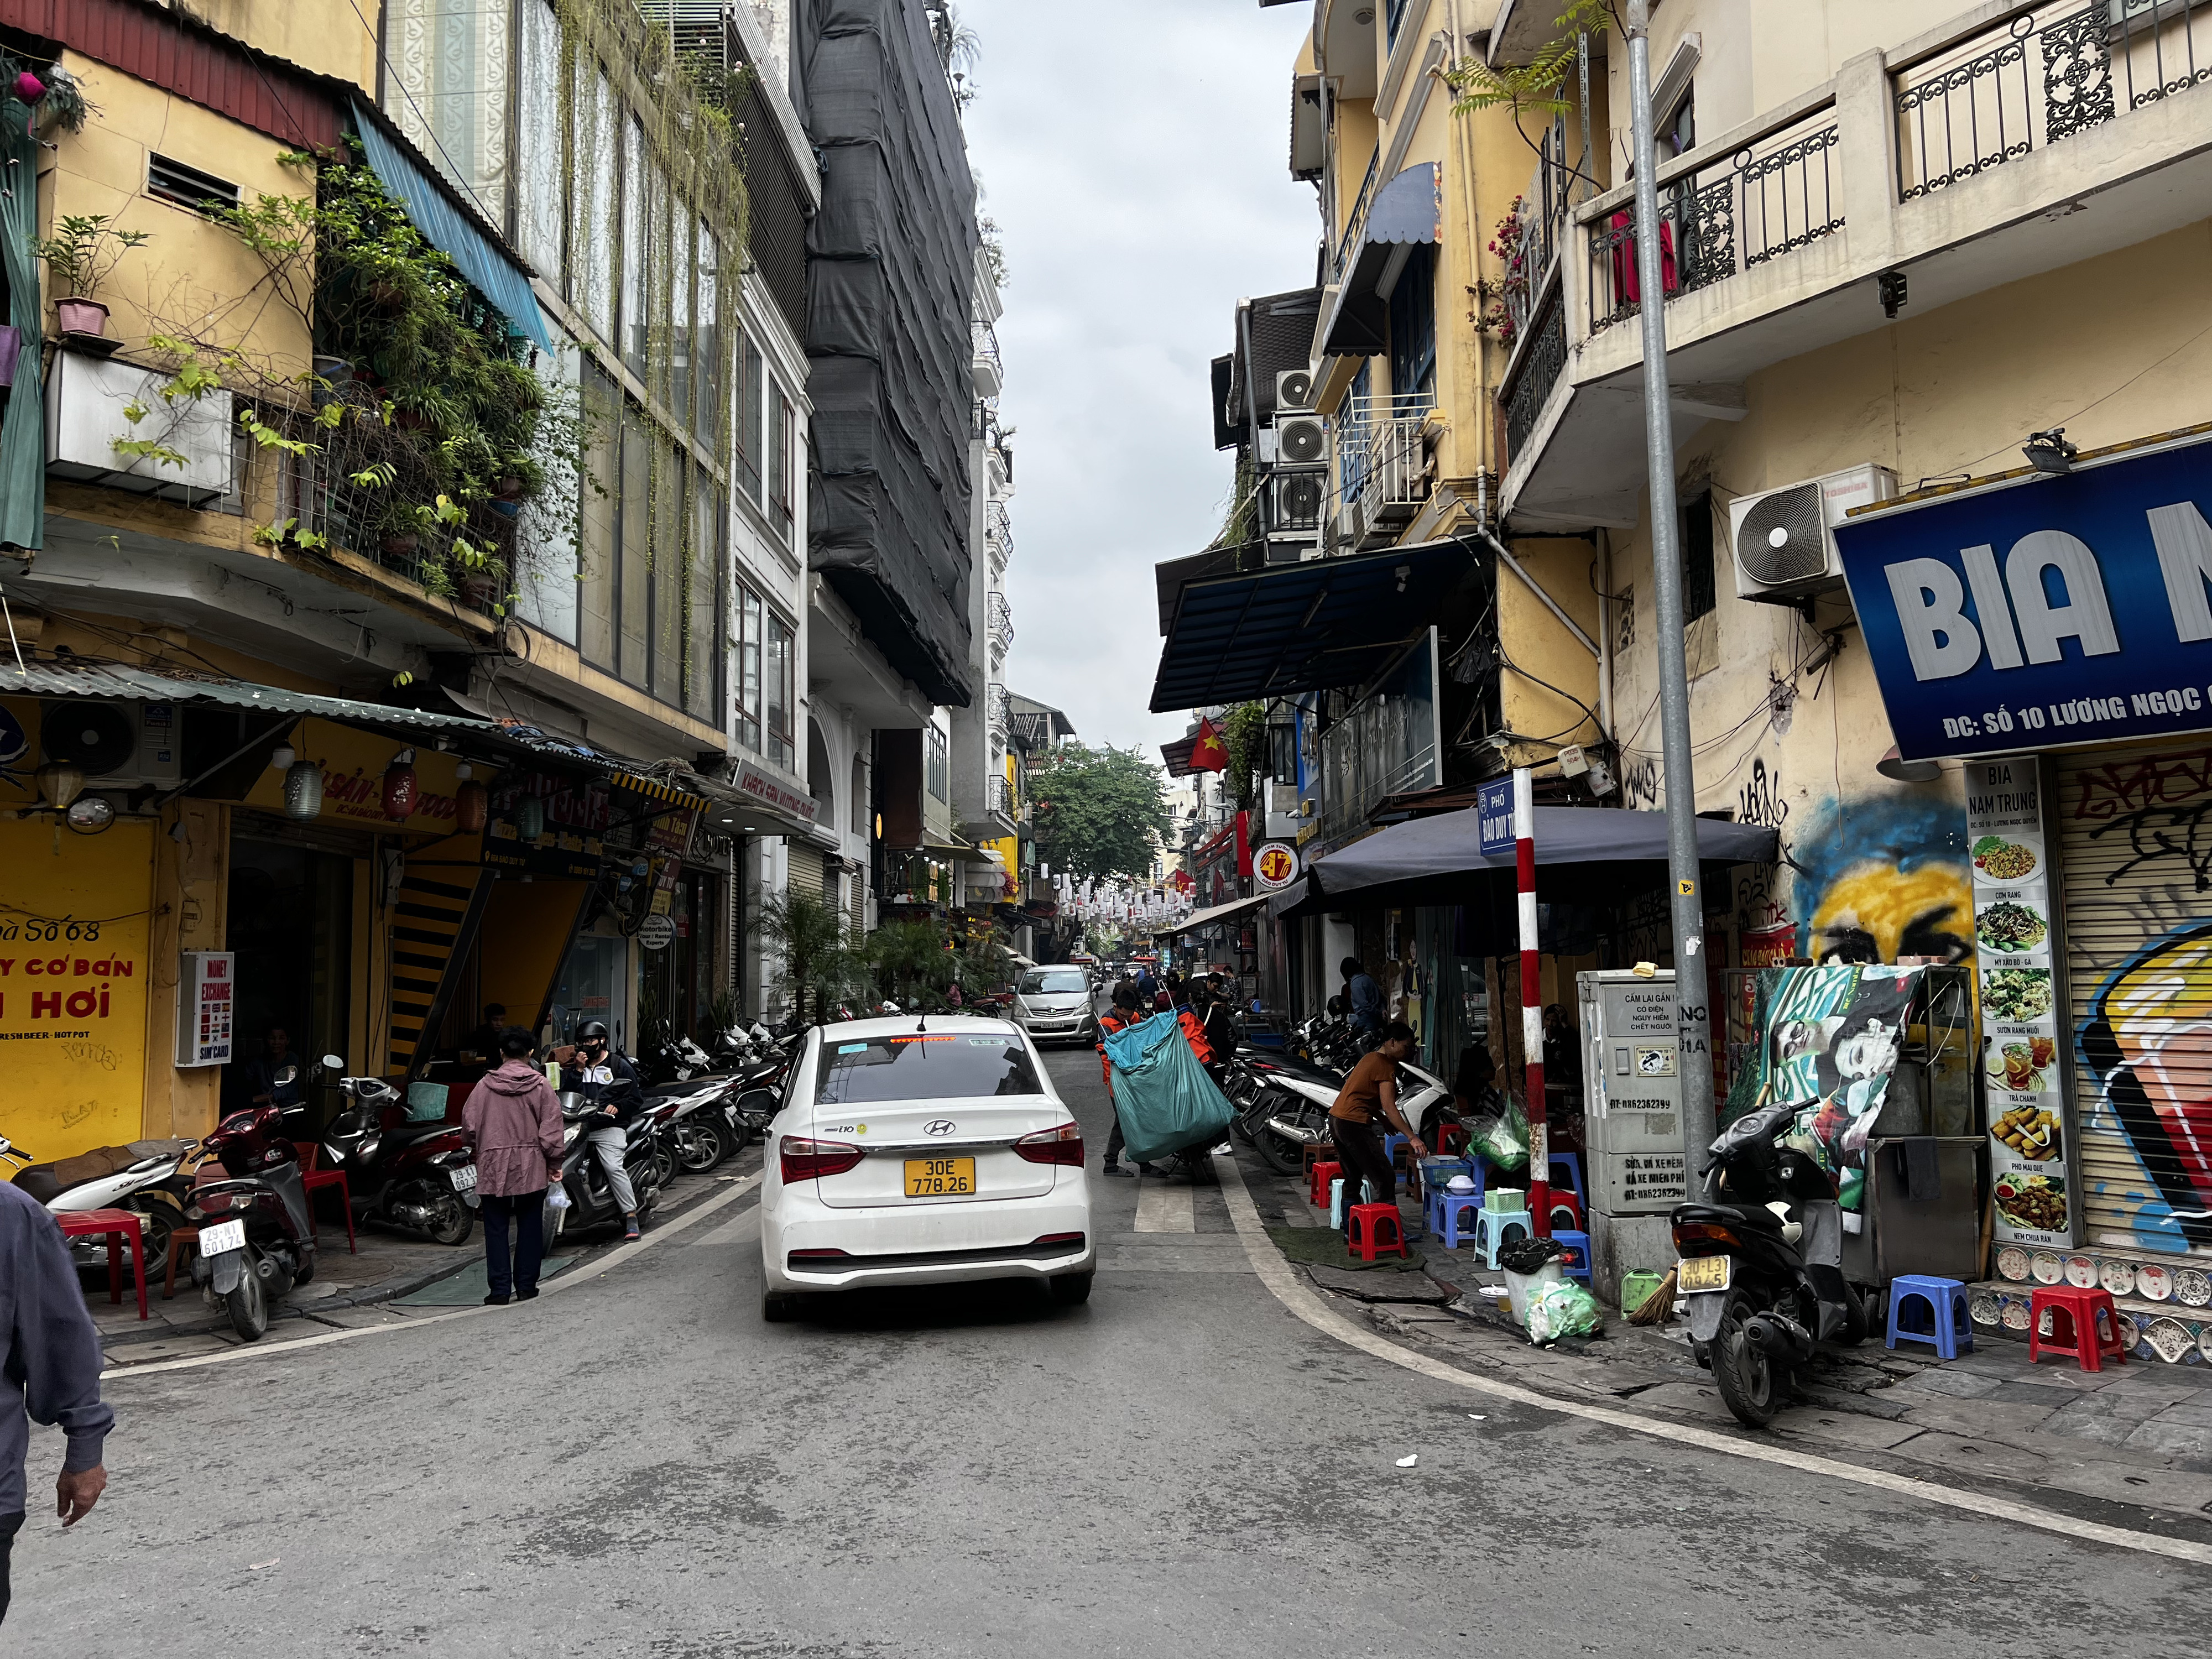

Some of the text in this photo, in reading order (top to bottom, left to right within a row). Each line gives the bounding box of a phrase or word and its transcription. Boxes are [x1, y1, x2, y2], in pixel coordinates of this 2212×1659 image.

[1825, 482, 1868, 498] TOSHIBA
[1884, 529, 2120, 682] BIA
[1943, 716, 1980, 739] ĐC:
[1985, 705, 2014, 734] SỐ
[2017, 707, 2045, 729] 10
[2049, 697, 2127, 726] LƯƠNG
[2131, 687, 2201, 716] NGỌC
[1988, 765, 2012, 785] BIA
[1491, 787, 1504, 808] PHỐ
[1969, 791, 2036, 815] NAM TRUNG
[1483, 813, 1494, 842] ĐÀO
[1495, 814, 1507, 840] DUY
[1260, 853, 1291, 878] 47
[66, 922, 99, 942] 68
[207, 960, 227, 978] MONEY
[202, 982, 231, 1001] EXCHANGE
[1625, 992, 1641, 1003] CẤM
[1642, 994, 1653, 1004] LẠI
[1648, 1005, 1663, 1014] ĐIỆN
[1653, 1012, 1669, 1021] HIỂM
[200, 1045, 228, 1060] SIM CARD
[2009, 1093, 2019, 1102] TRÀ
[454, 1167, 474, 1180] 29-K1
[925, 1160, 954, 1176] 30E
[2033, 1164, 2043, 1172] QUE
[913, 1177, 967, 1193] 778.26
[206, 1223, 236, 1241] 29-N1
[2025, 1233, 2039, 1241] CHUA
[205, 1234, 241, 1254] 601.74
[1686, 1258, 1721, 1275] 30-L3
